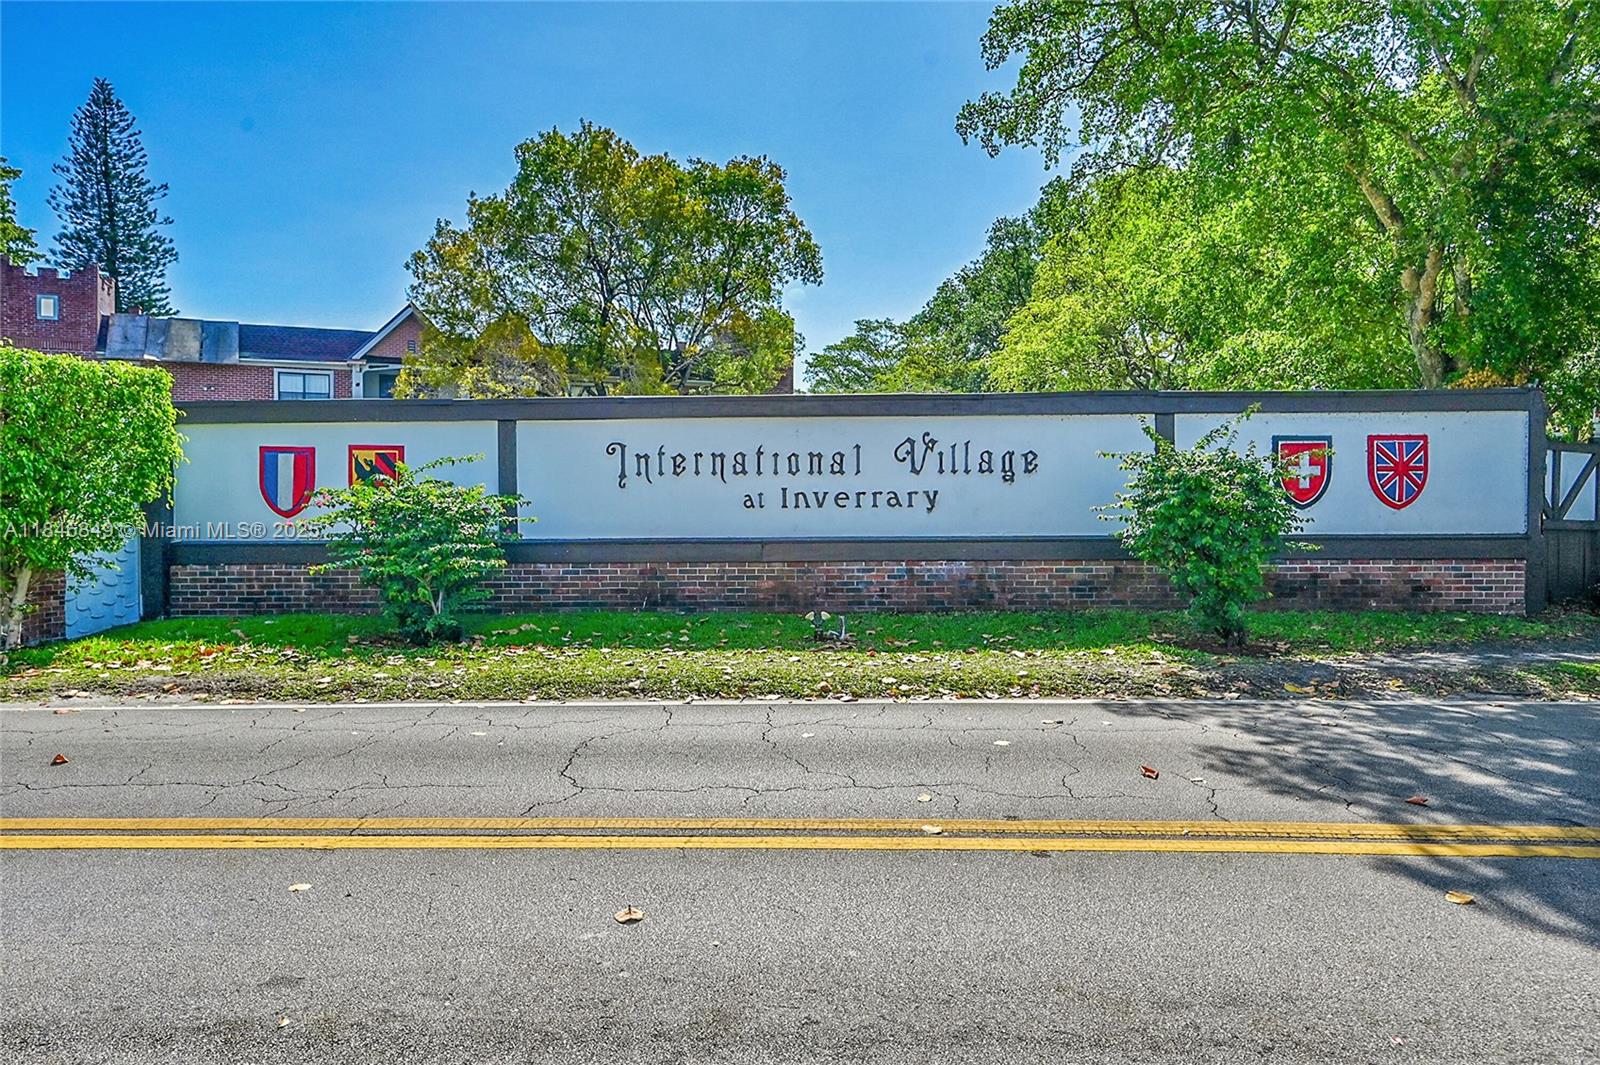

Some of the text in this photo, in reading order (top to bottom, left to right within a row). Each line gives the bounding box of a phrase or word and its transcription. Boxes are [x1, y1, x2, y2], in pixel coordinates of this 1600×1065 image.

[606, 432, 1039, 488] International Village
[743, 487, 940, 513] at Inverrary
